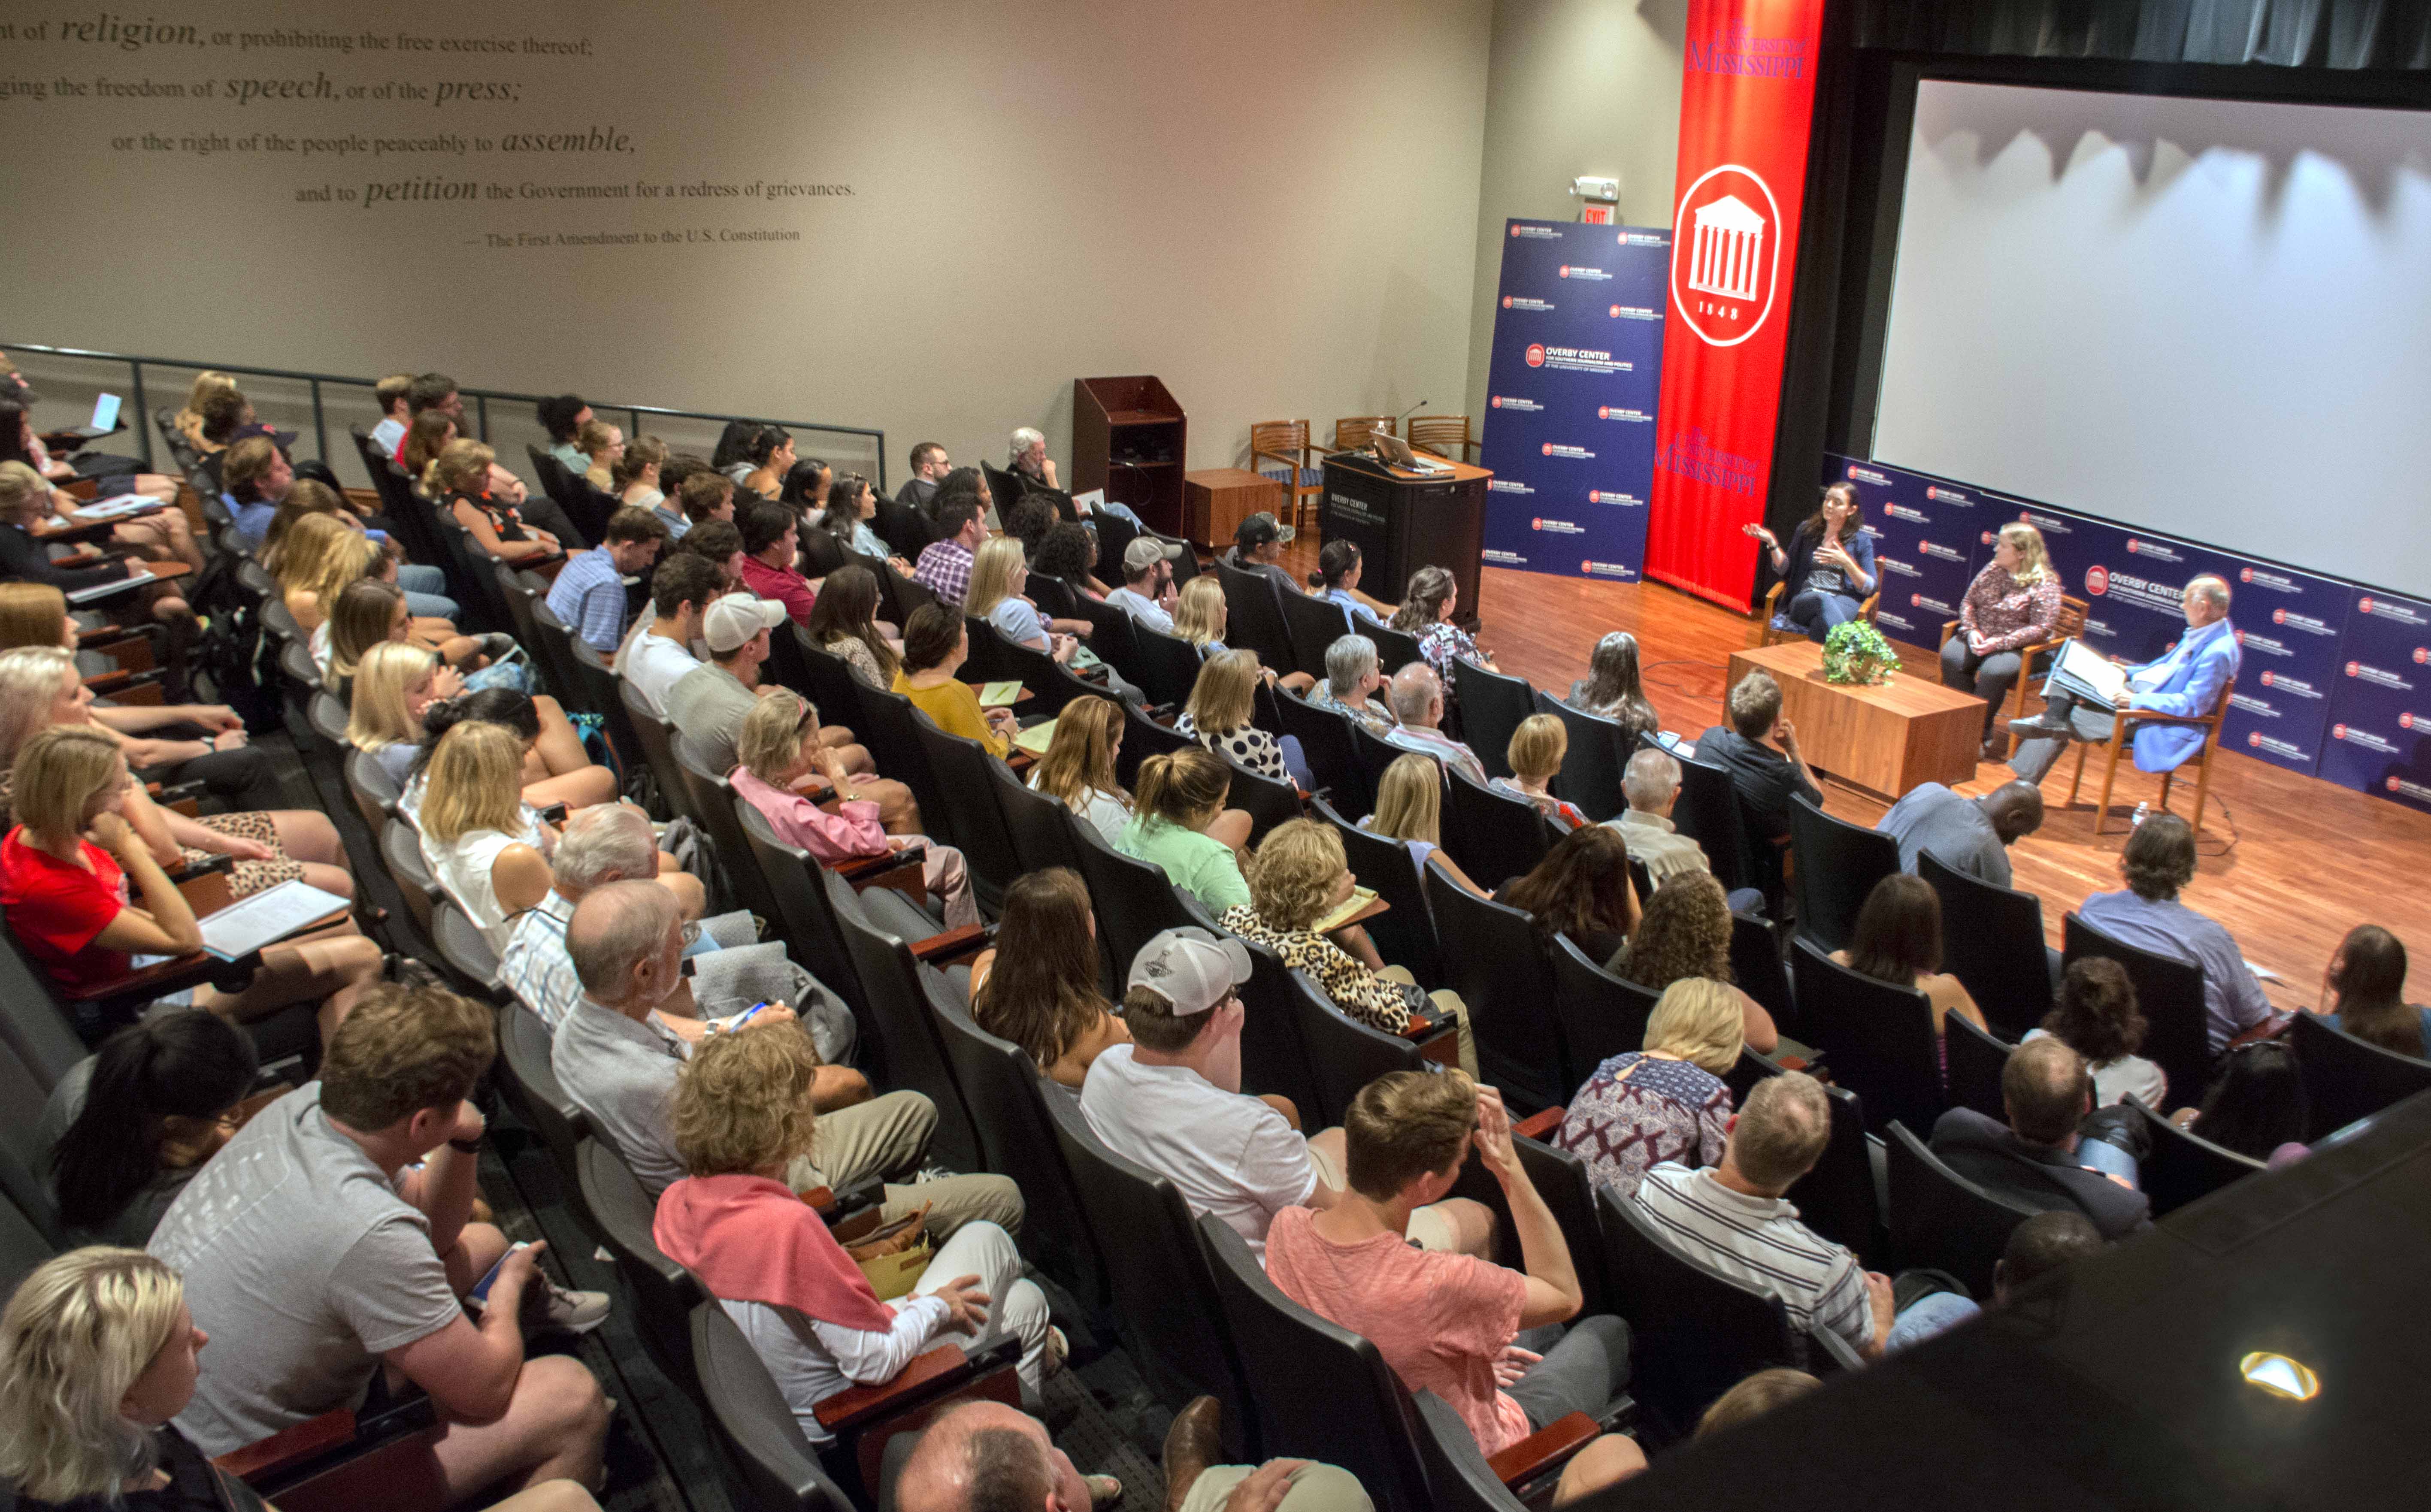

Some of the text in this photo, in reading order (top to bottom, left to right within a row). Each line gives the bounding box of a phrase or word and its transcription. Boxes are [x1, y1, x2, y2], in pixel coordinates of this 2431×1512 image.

[22, 20, 50, 41] of
[61, 13, 206, 51] religion,
[211, 32, 233, 45] or
[239, 28, 354, 54] prohibiting
[359, 30, 390, 50] the
[397, 32, 434, 51] free
[439, 38, 517, 54] exercise
[522, 36, 593, 57] thereof;
[53, 77, 88, 97] the
[95, 77, 186, 97] freedom
[191, 79, 216, 98] of
[224, 71, 340, 106] speech,
[345, 86, 366, 99] or
[372, 81, 395, 100] of
[398, 82, 428, 100] the
[434, 82, 522, 108] press;
[111, 125, 635, 157] or the right of the people peaceably to assemble,
[295, 176, 855, 209] and to petition the Government for a redress of grievances.
[485, 233, 513, 247] The
[518, 233, 550, 246] First
[556, 232, 639, 245] Amendment
[643, 233, 657, 243] to
[661, 230, 682, 243] the
[686, 229, 715, 243] U.S.
[719, 229, 800, 242] Constitution
[1699, 301, 1738, 320] 1848
[1546, 347, 1610, 360] OVERBY CENTER
[1350, 498, 1368, 511] CENTER
[2109, 572, 2147, 590] OVERBY
